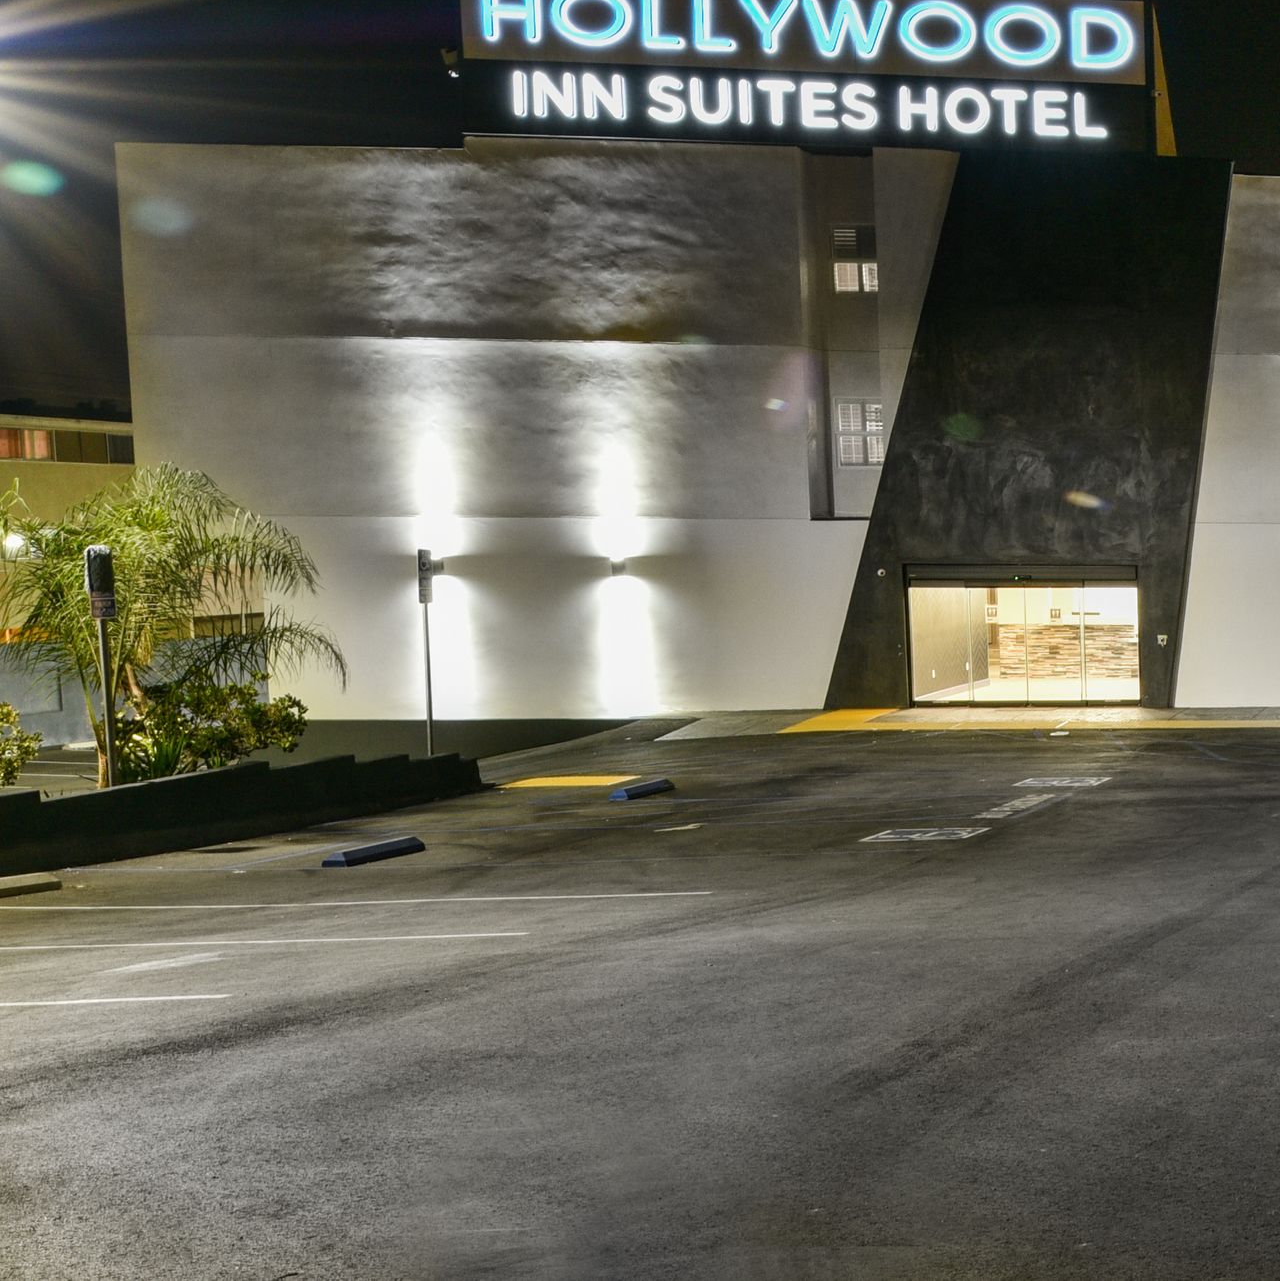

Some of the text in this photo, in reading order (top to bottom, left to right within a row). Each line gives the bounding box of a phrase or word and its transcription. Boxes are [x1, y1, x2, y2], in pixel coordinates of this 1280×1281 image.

[511, 70, 1109, 139] INN SUITES HOTEL
